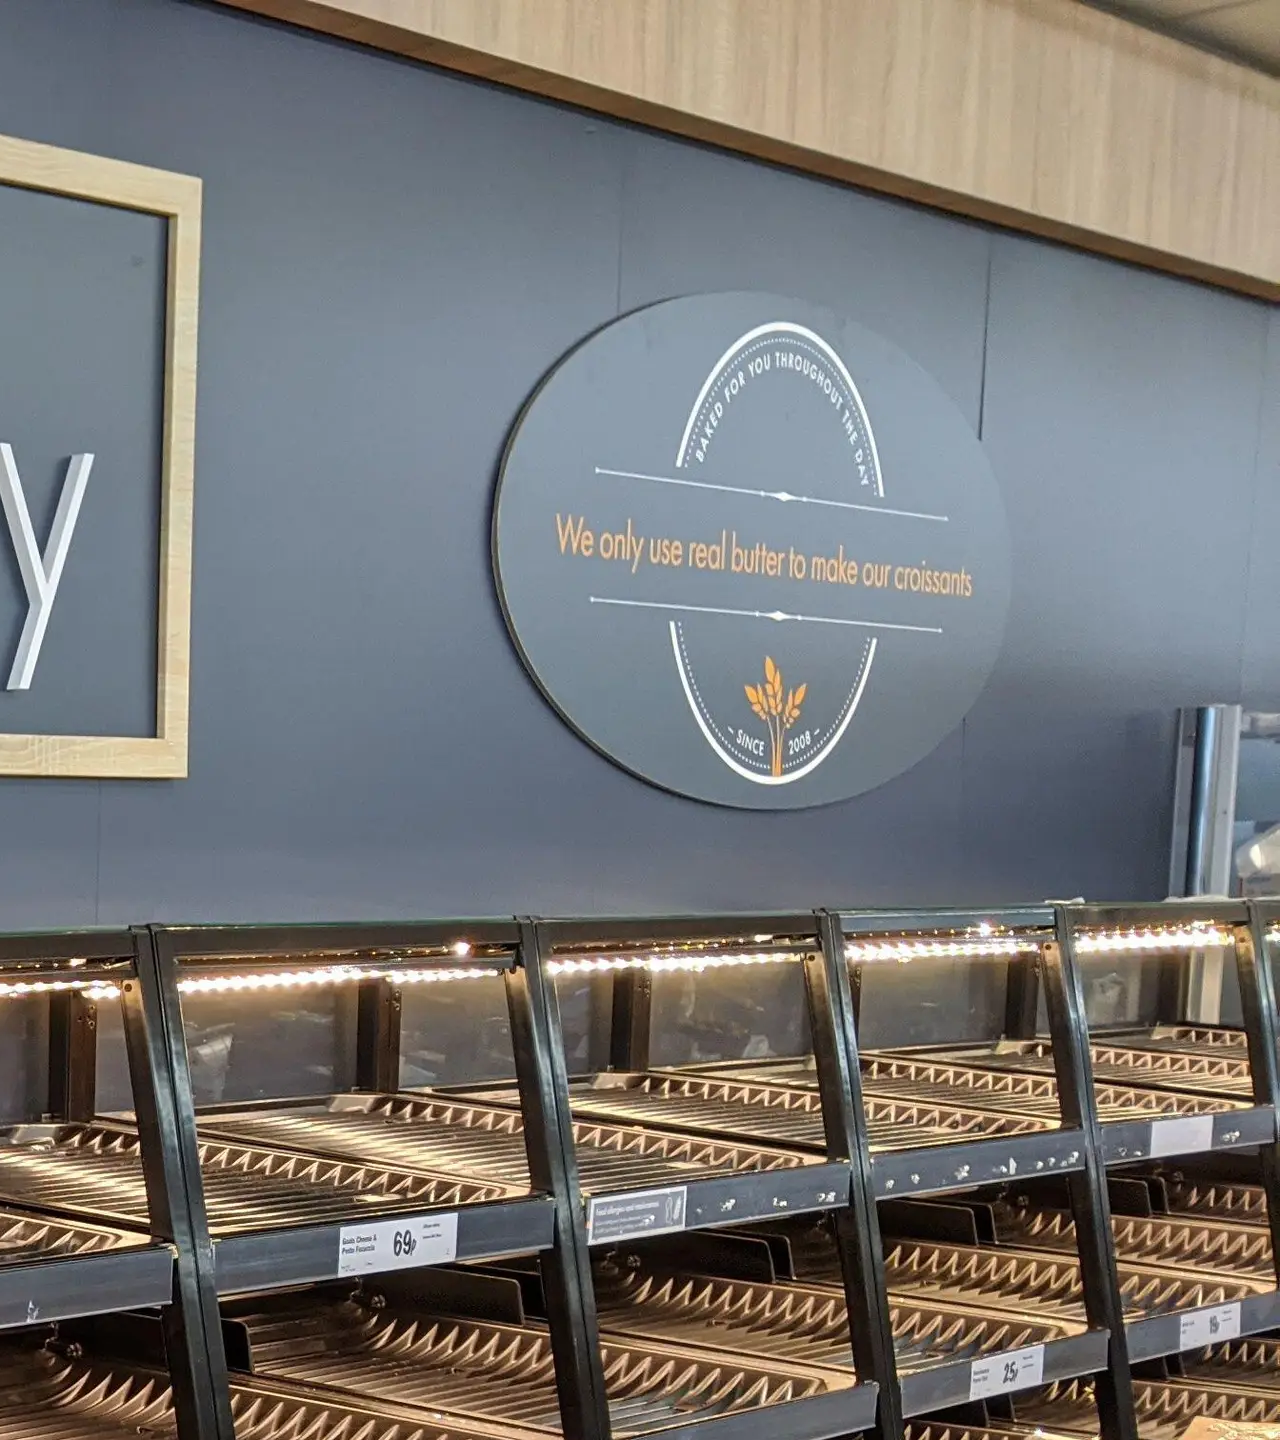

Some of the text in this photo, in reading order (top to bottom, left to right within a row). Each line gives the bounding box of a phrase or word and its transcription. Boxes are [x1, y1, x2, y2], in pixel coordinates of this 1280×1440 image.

[695, 351, 870, 486] BAKED FOR YOU THROUGHOUT THE DAY
[556, 512, 973, 598] We only use real butter to make our croissants
[736, 729, 812, 757] SINCE 2008
[393, 1229, 417, 1257] 69p
